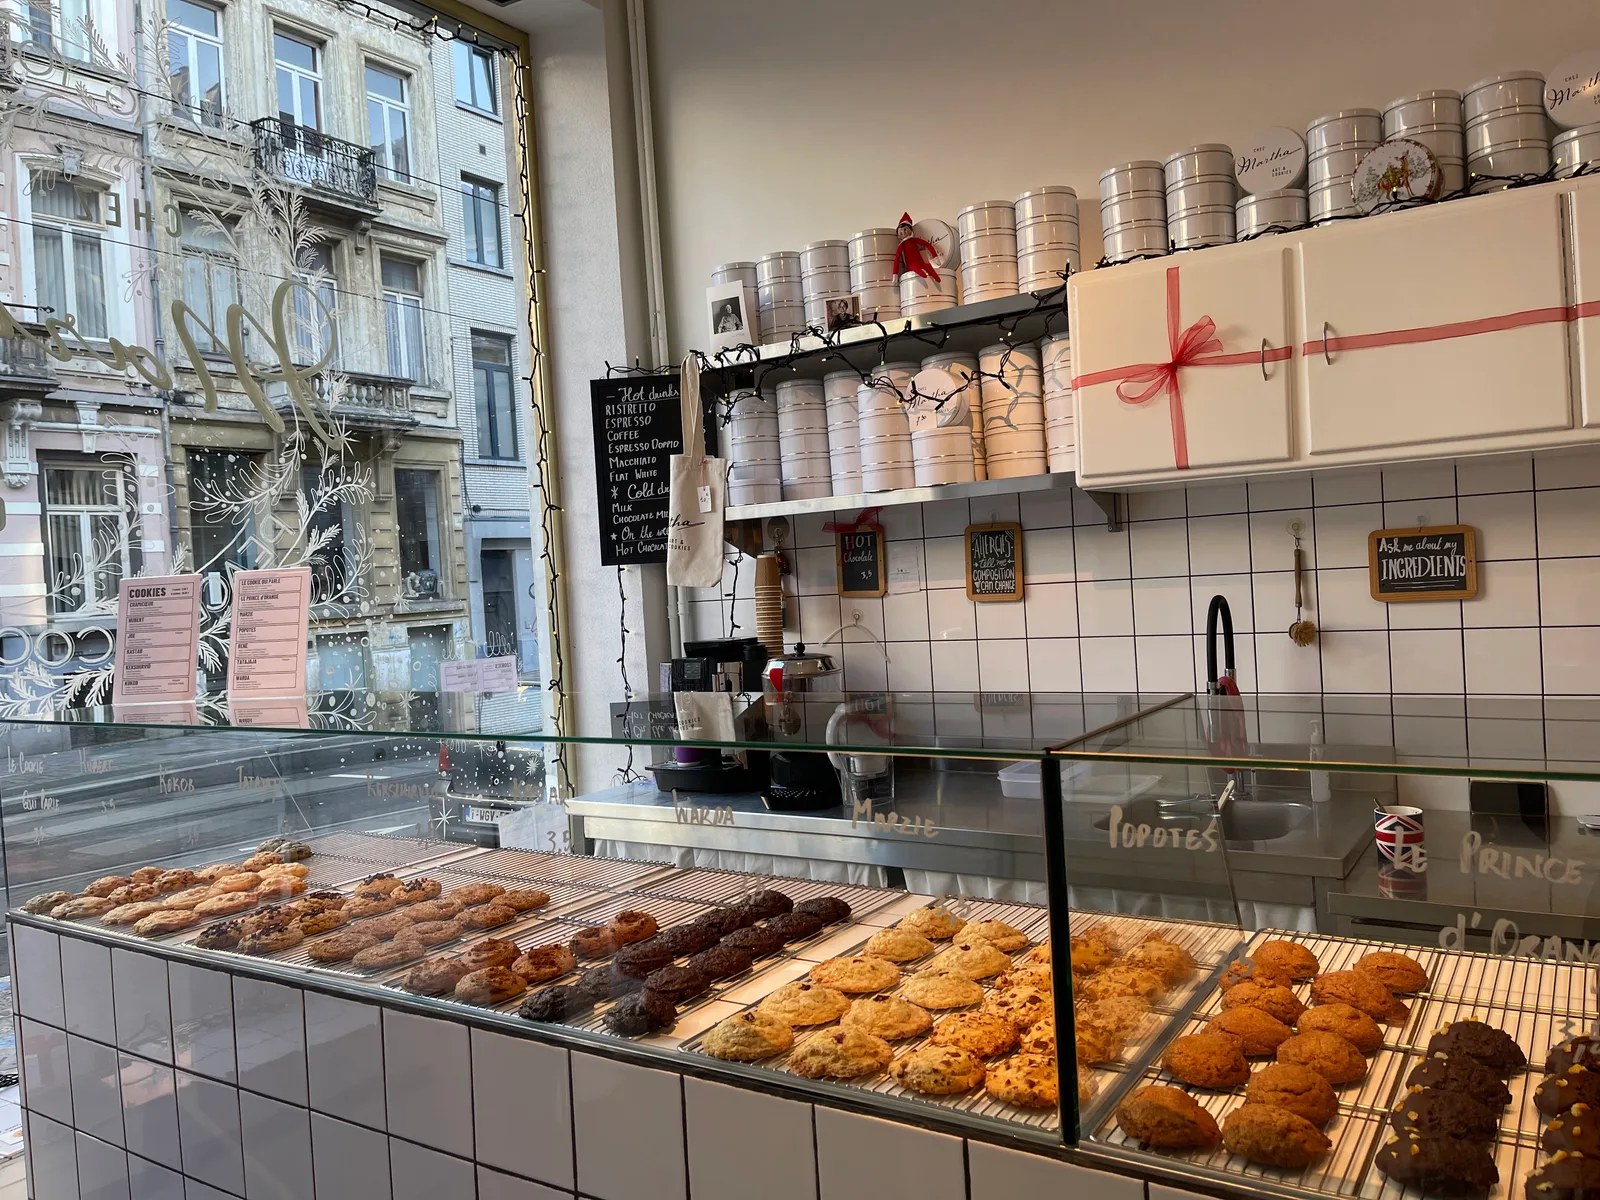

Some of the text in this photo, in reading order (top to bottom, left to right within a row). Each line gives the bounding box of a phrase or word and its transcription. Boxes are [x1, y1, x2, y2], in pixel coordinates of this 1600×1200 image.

[1237, 147, 1302, 176] Martha
[618, 386, 645, 402] Hot
[605, 402, 656, 416] RISTRETTO
[605, 415, 652, 429] ESPRESSO
[607, 430, 640, 441] COFFEE
[608, 438, 680, 454] ESPRESSO DOPPIO
[608, 456, 657, 469] MACCHIATO
[609, 469, 657, 482] FLAT WHITE
[627, 481, 655, 499] Cold
[612, 502, 632, 513] MILK
[656, 510, 669, 519] MIL
[621, 526, 636, 540] On
[640, 525, 653, 539] the
[845, 534, 874, 550] HOT
[1379, 537, 1457, 558] Ask me about my
[615, 542, 633, 557] HOT
[843, 550, 873, 563] Chocolate
[979, 557, 996, 568] tell
[1381, 554, 1467, 581] INGREDIENTS
[860, 569, 873, 580] 3,5
[972, 567, 1015, 581] COMPOSITION
[994, 580, 1015, 591] CHANGE
[129, 587, 167, 599] COOKIES
[1109, 804, 1221, 853] POPOTES
[1457, 830, 1587, 885] PRINCE
